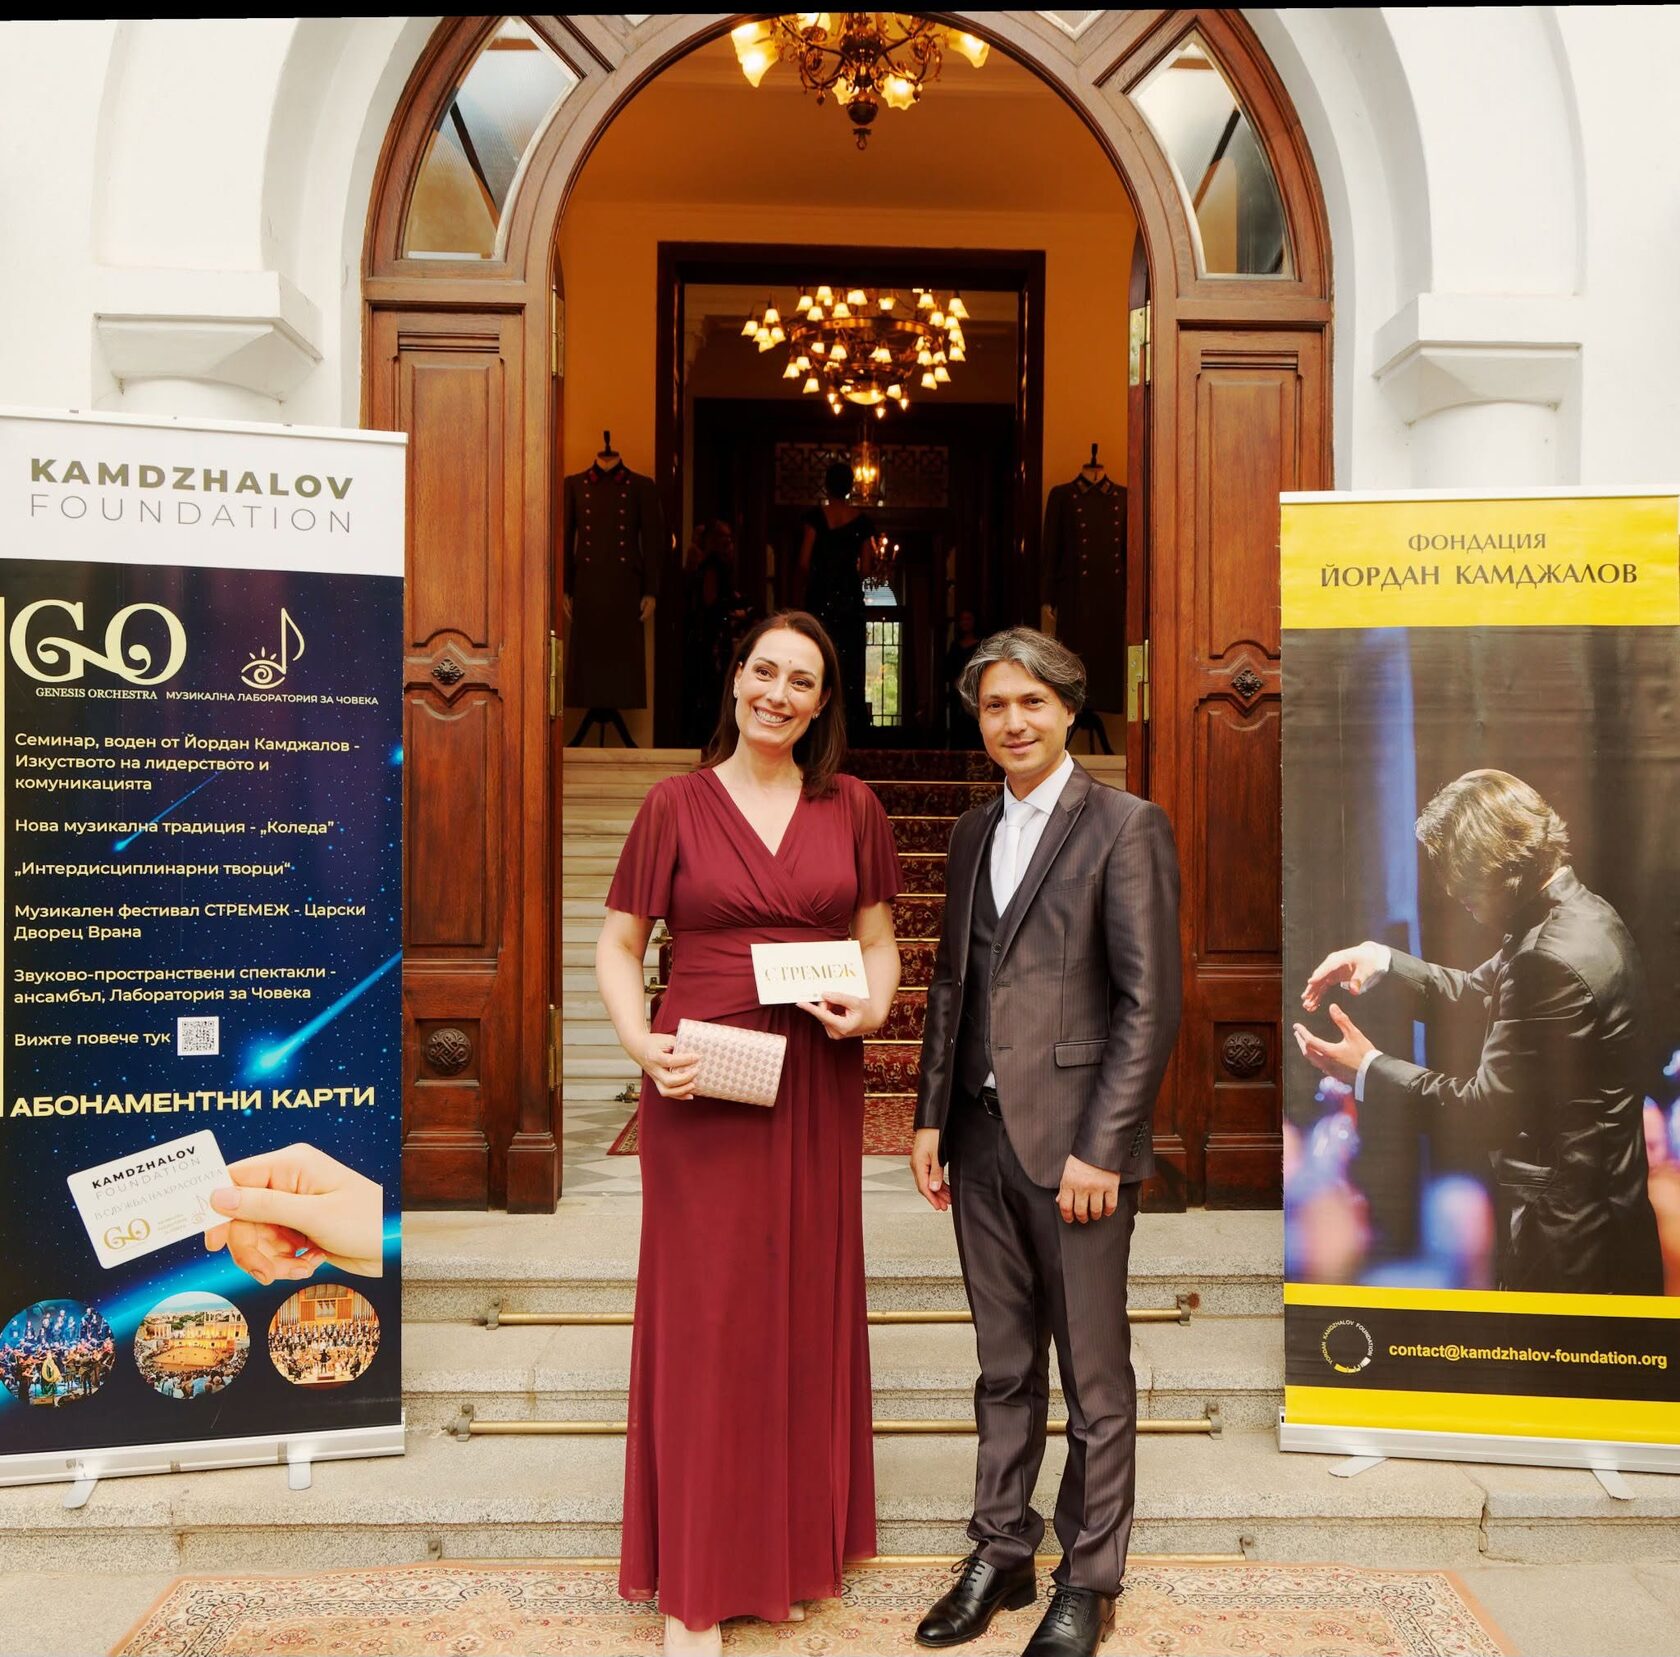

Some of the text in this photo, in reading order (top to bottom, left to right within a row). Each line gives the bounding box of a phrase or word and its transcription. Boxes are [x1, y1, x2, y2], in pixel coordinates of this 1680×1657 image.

[31, 458, 353, 499] KAMDZHALOV
[31, 494, 350, 534] FOUNDATION
[1408, 533, 1546, 554] ФОНДАЦИЯ
[1321, 563, 1637, 591] ЙОРДАН КАМДЖАЛОВ
[36, 688, 157, 700] GENESIS ORCHESTRA
[166, 691, 379, 706] МУЗИКАЛНА ЛАБОРАТОРИЯ ЗА ЧОВЕКА
[15, 733, 100, 750] Семинар,
[105, 737, 156, 751] воден
[160, 737, 180, 749] от
[184, 734, 250, 752] Йордан
[255, 737, 349, 753] Камджалов
[15, 755, 269, 775] Изкуството на лидерството и
[15, 779, 152, 794] комуникацията
[15, 820, 59, 832] Нова
[64, 821, 158, 837] музикална
[162, 821, 245, 837] традиция
[14, 862, 219, 878] „Интердисциплинарни
[15, 904, 115, 921] Музикален
[119, 904, 199, 920] фестивал
[204, 903, 290, 917] СТРЕМЕЖ
[304, 904, 365, 920] Царски
[14, 926, 141, 942] Дворец Врана
[14, 967, 235, 984] Звуково-пространствени
[240, 966, 326, 982] спектакли
[765, 963, 856, 982] СТРЕМЕЖ
[14, 987, 311, 1005] ансамбъл, Лаборатория за Човека
[14, 1032, 171, 1049] Вижте повече тук
[10, 1087, 375, 1118] АБОНАМЕНТНИ КАРТИ
[92, 1146, 195, 1189] KAMDZHALOV
[95, 1157, 201, 1200] FOUNDATION
[1321, 1319, 1373, 1365] YORDAN KAMDZHALOV FOUNDATION
[1389, 1343, 1668, 1369] contact@kamdzhalov-foundation.org
